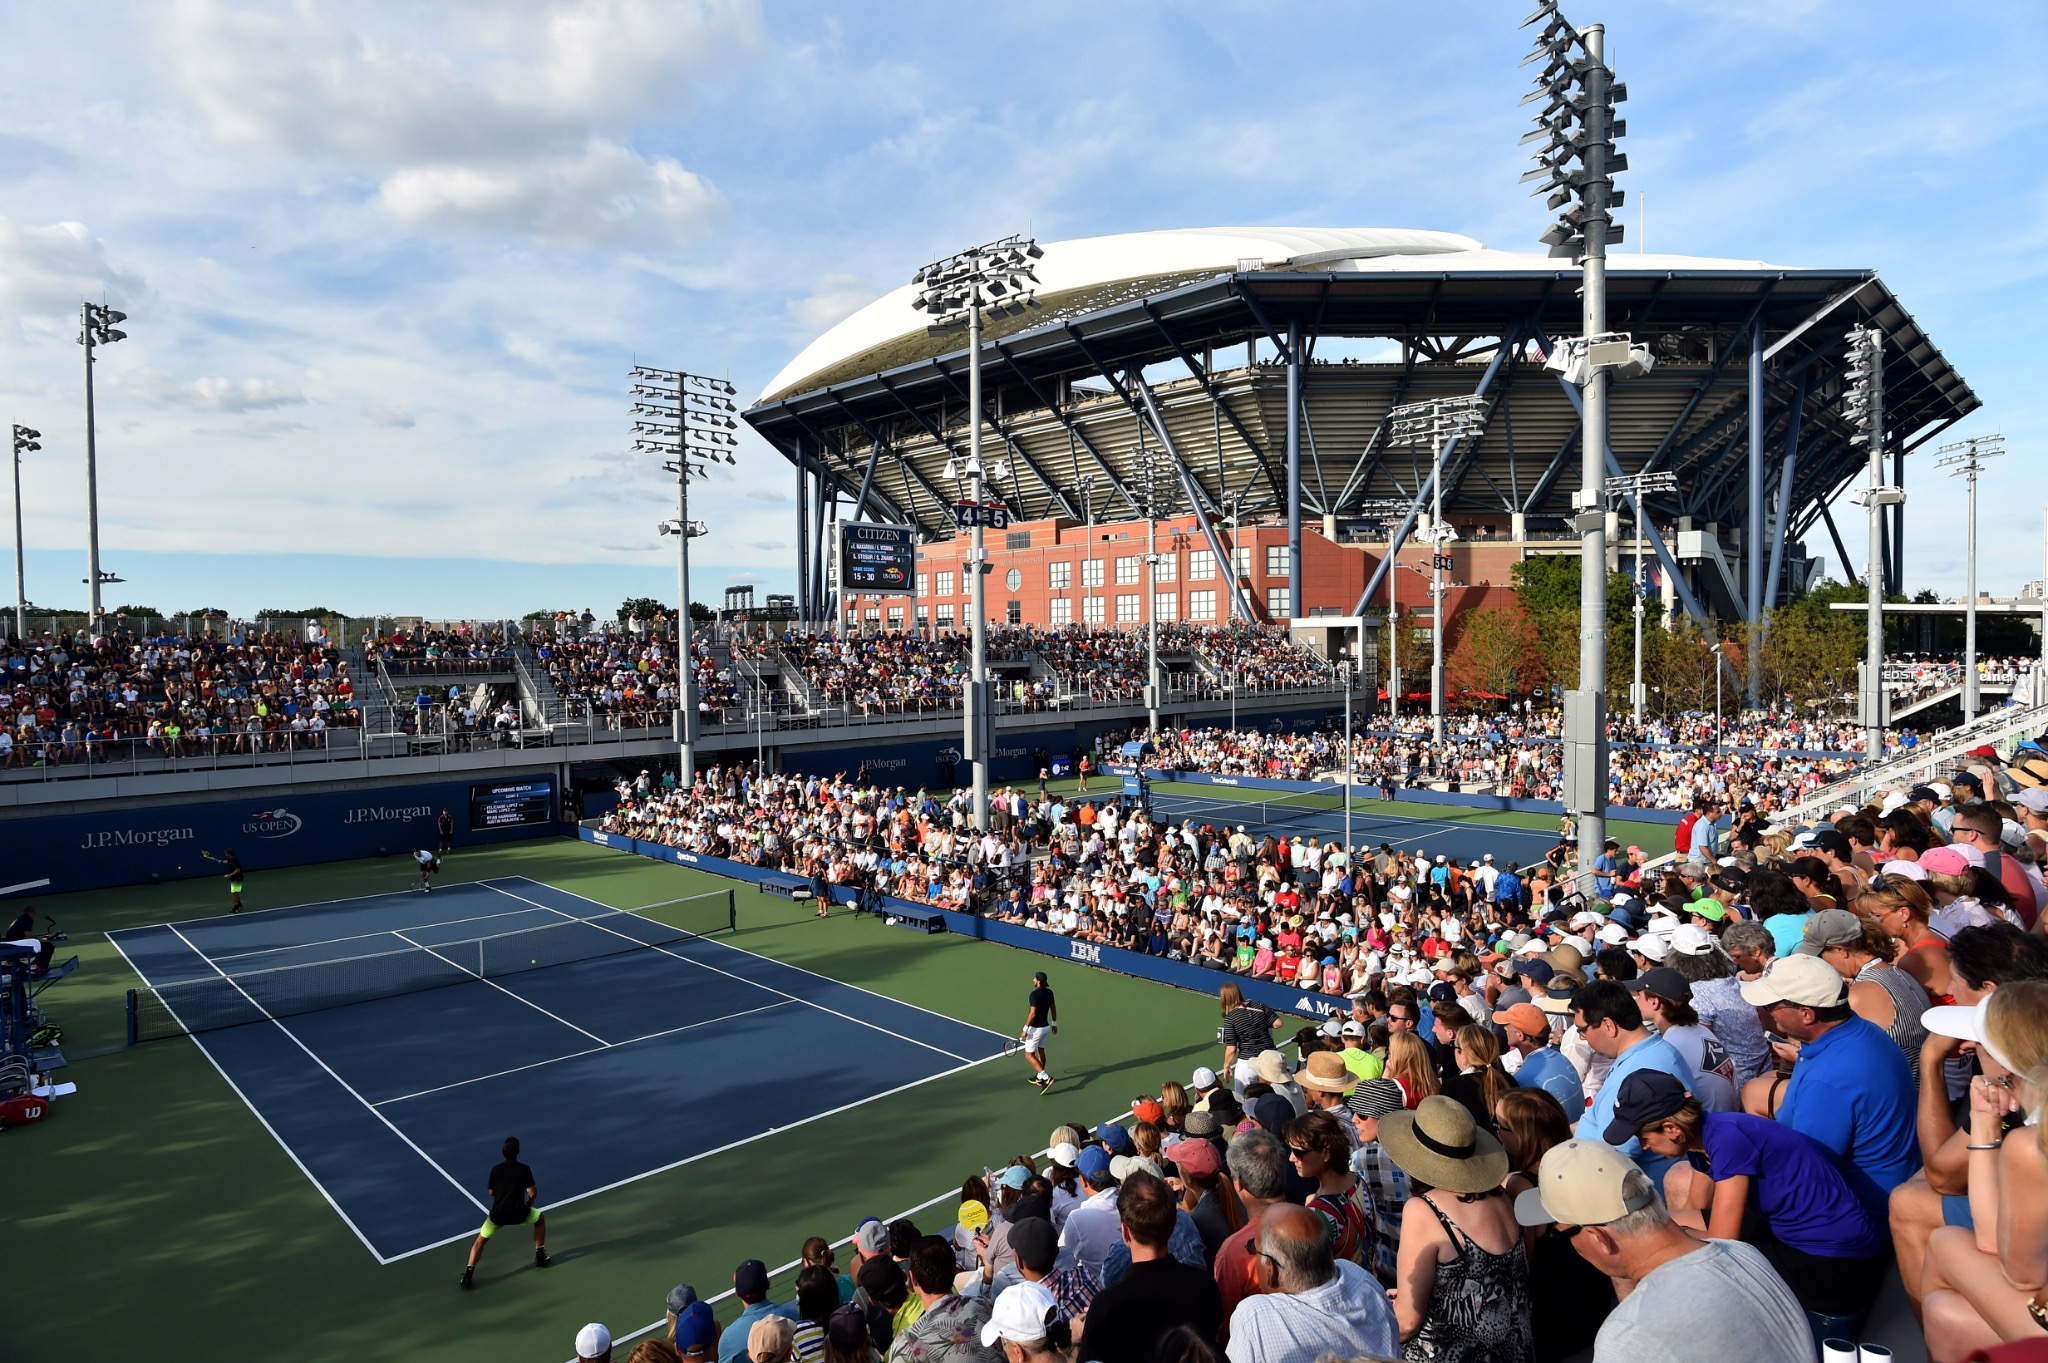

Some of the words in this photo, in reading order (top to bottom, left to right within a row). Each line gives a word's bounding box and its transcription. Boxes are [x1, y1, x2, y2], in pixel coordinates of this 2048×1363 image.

[962, 508, 973, 525] 4
[994, 510, 1004, 528] 5
[857, 528, 900, 541] CITIZEN
[1435, 557, 1440, 568] 5
[1447, 559, 1452, 569] 6
[853, 572, 861, 580] 15
[867, 573, 875, 581] 30
[995, 747, 1026, 759] P.Morgan
[344, 805, 432, 824] J.P.Morgan
[242, 822, 258, 834] US
[259, 819, 294, 832] OPEN
[81, 827, 194, 849] J.P.Morgan
[1071, 941, 1100, 963] IBM
